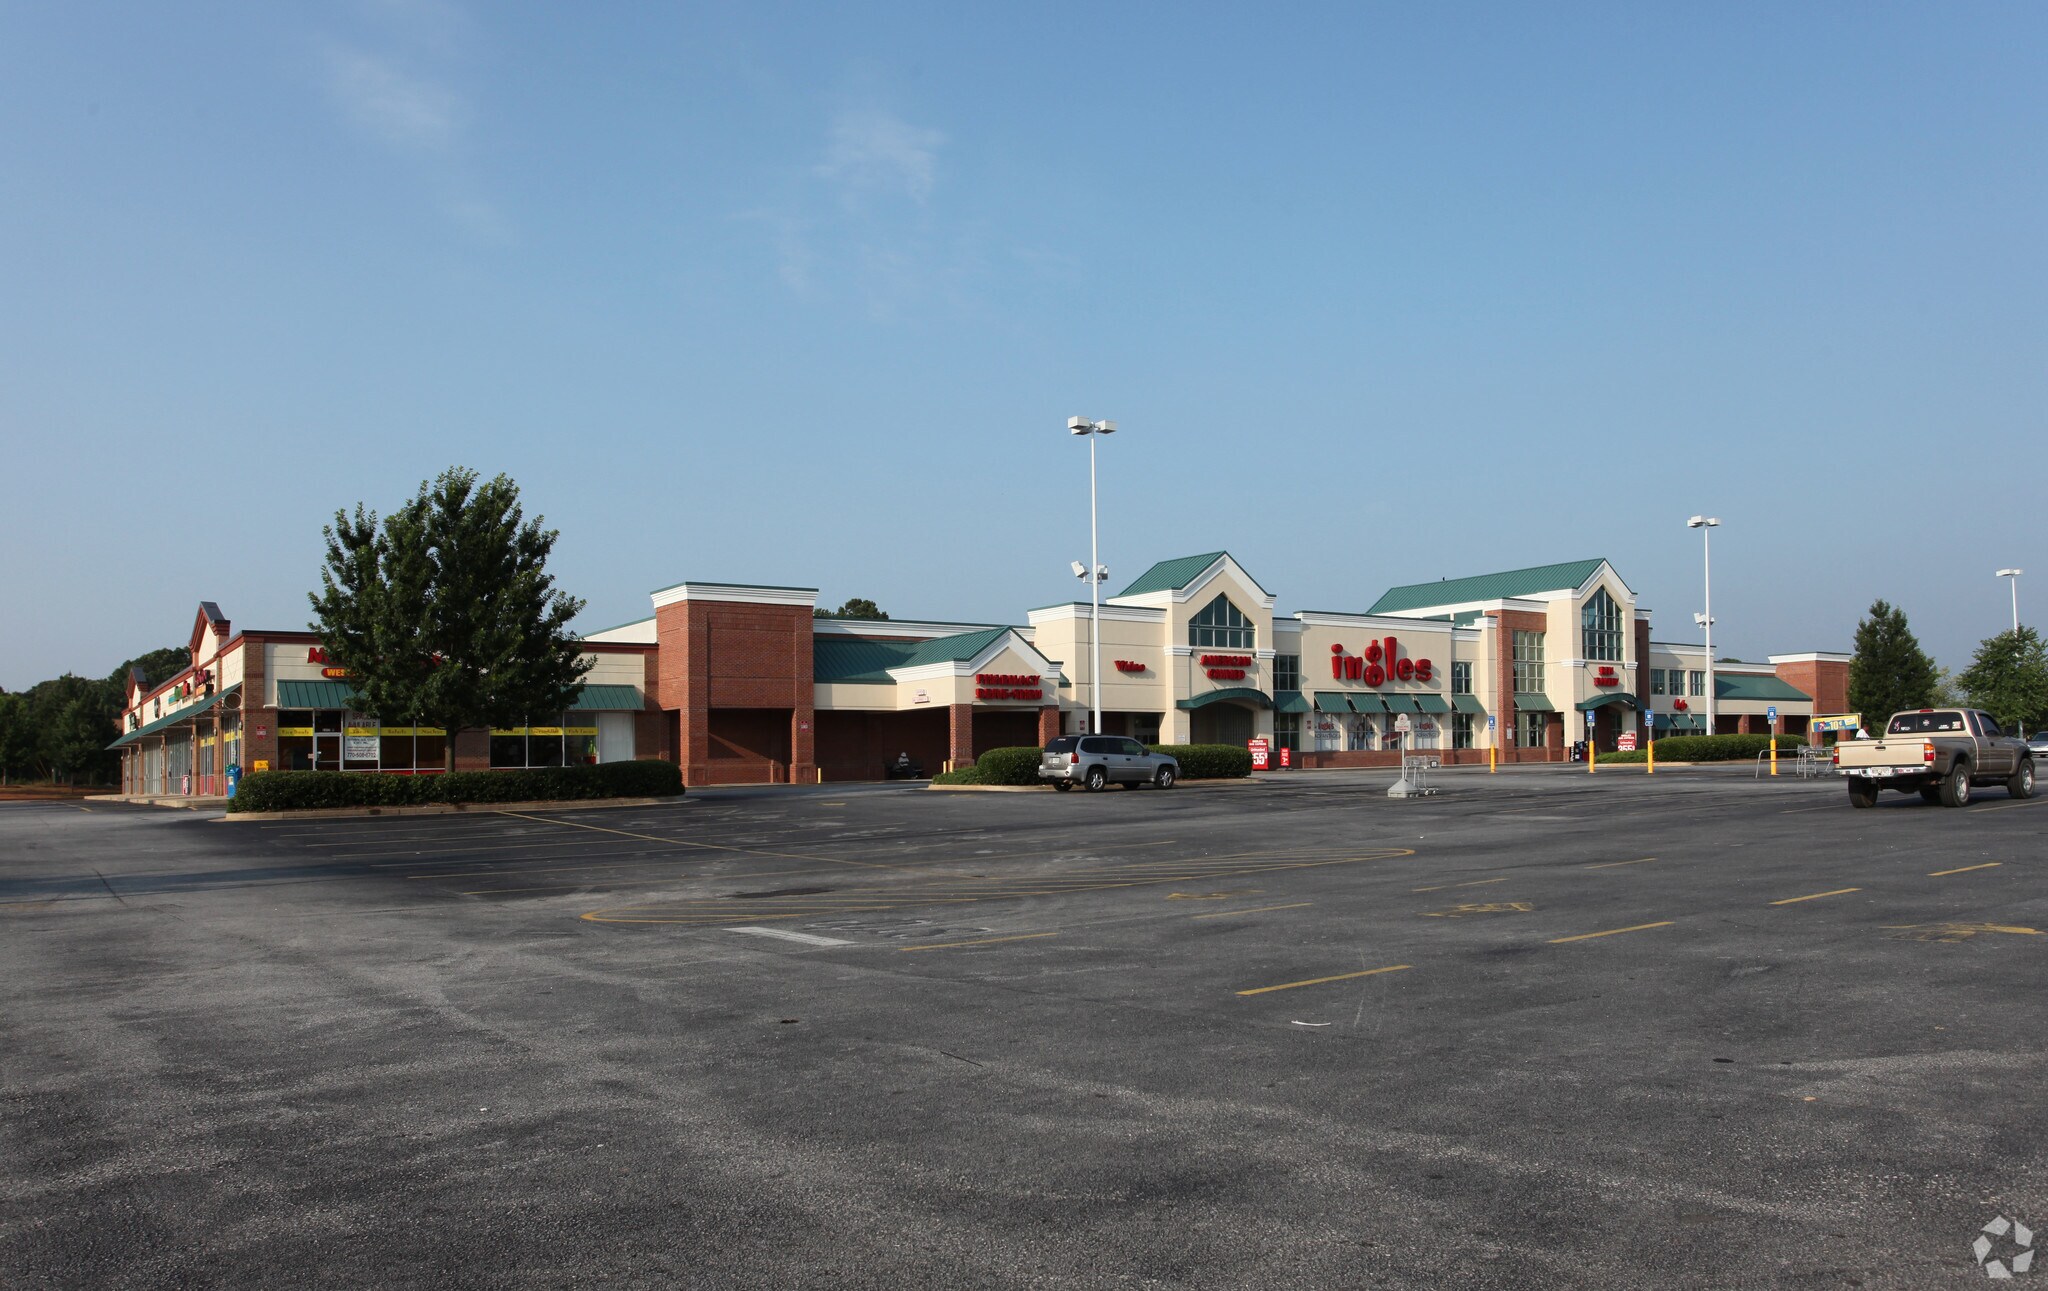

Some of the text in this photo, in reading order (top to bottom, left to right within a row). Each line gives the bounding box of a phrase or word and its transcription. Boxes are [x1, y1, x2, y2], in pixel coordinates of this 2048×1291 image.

[1201, 655, 1252, 666] AMERICAN
[1331, 637, 1432, 687] ingles
[976, 674, 1040, 686] PHARMACY
[1207, 669, 1245, 680] OWNED
